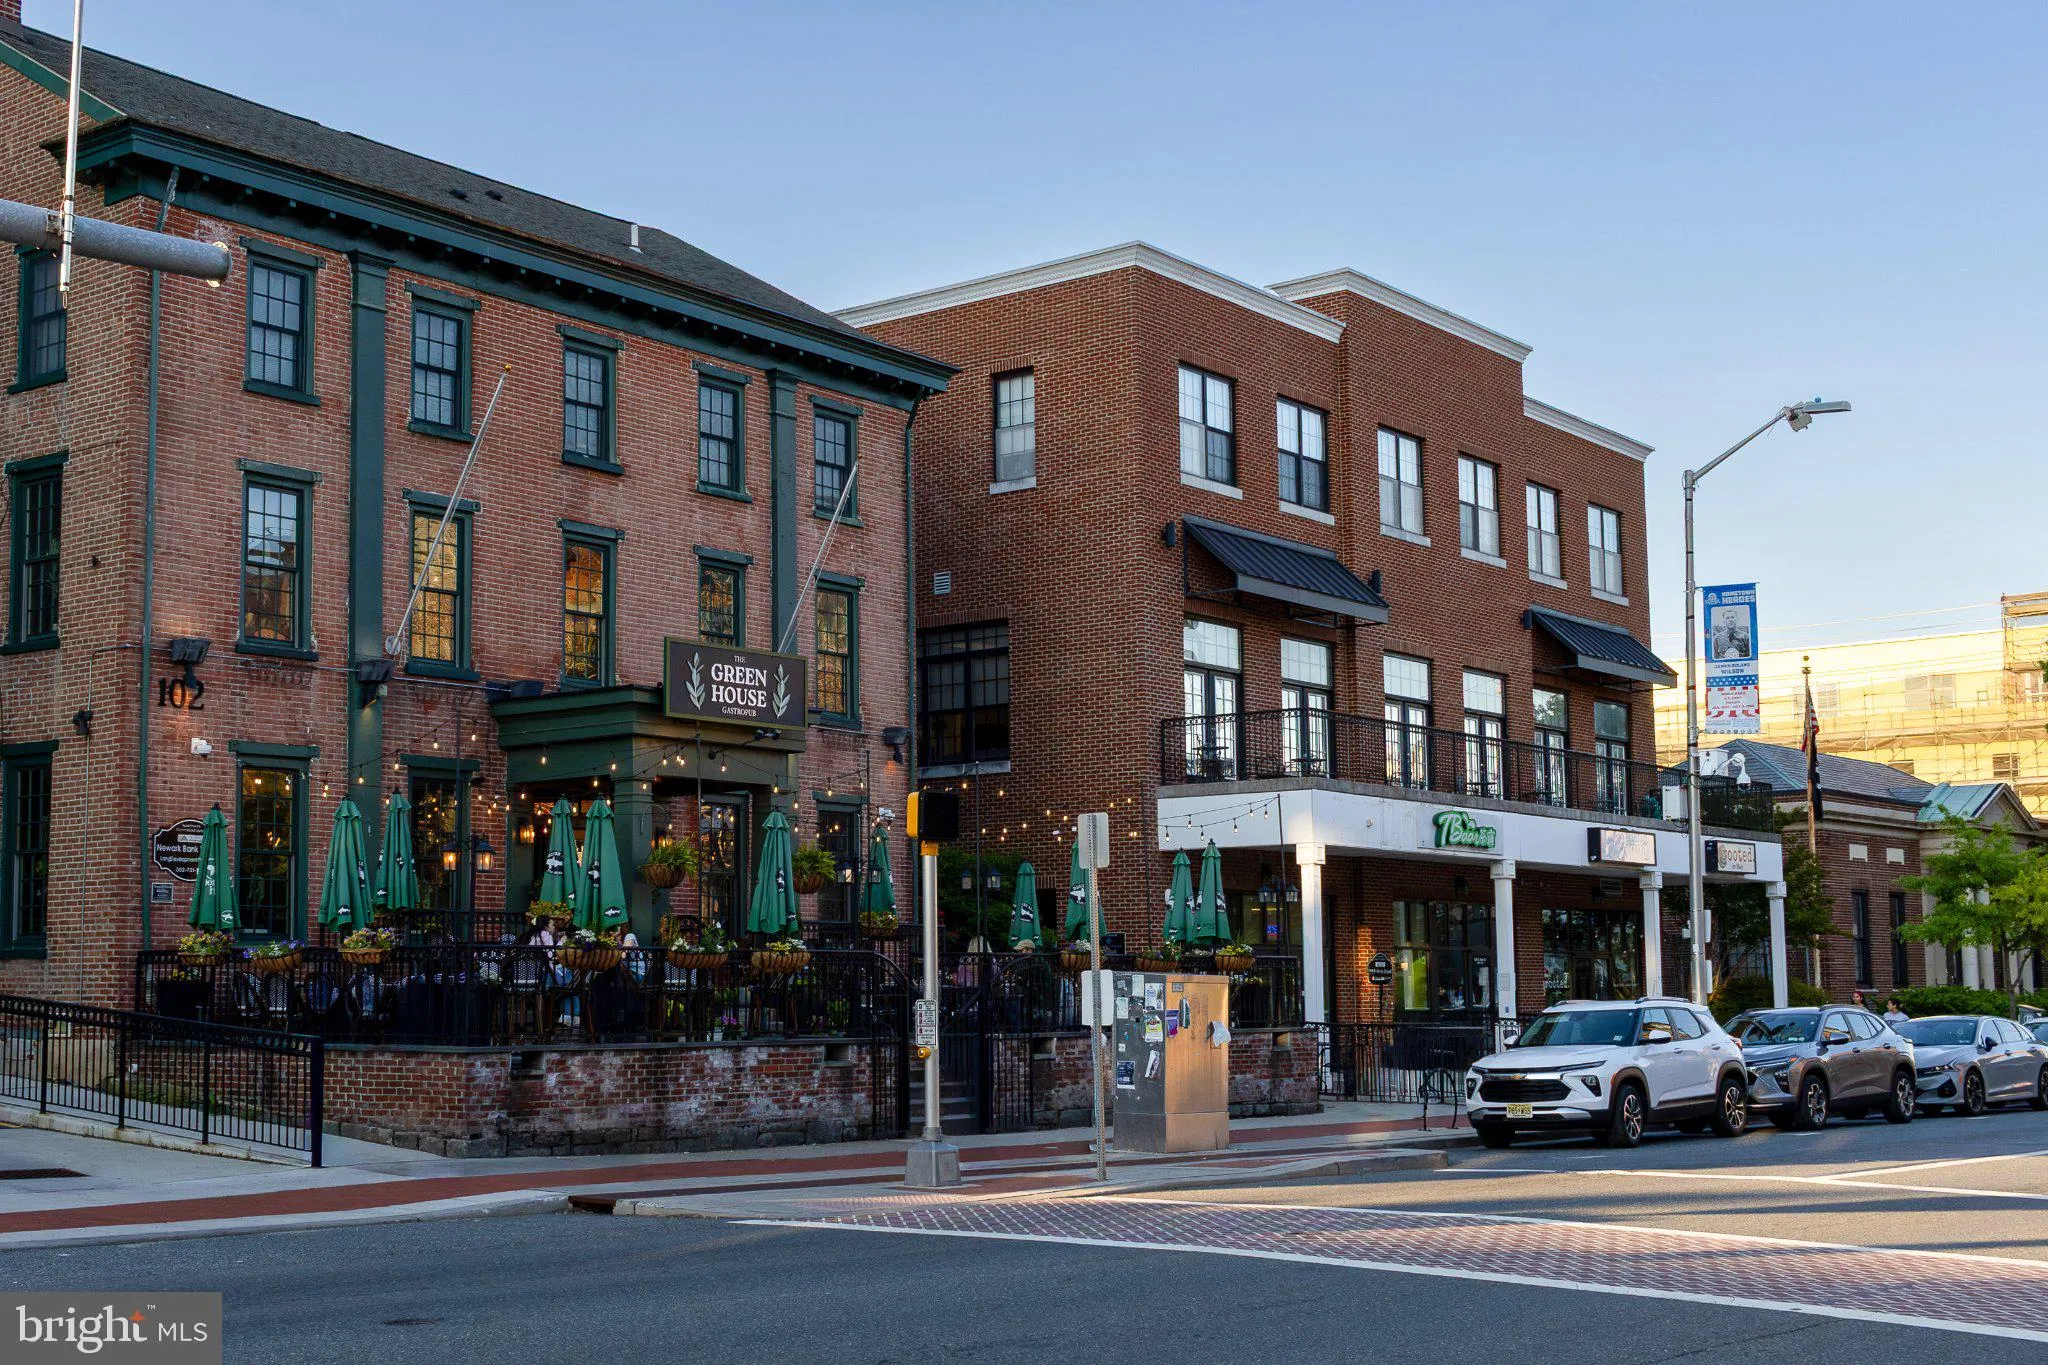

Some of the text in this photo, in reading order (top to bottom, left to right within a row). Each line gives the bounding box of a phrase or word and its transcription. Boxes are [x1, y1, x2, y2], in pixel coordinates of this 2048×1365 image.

[1721, 595, 1755, 604] HEROES
[734, 655, 746, 663] THE
[711, 663, 767, 687] GREEN
[158, 678, 205, 709] 102
[711, 684, 767, 708] HOUSE
[721, 706, 757, 717] GASTROPUB
[156, 844, 199, 853] Newark Bank
